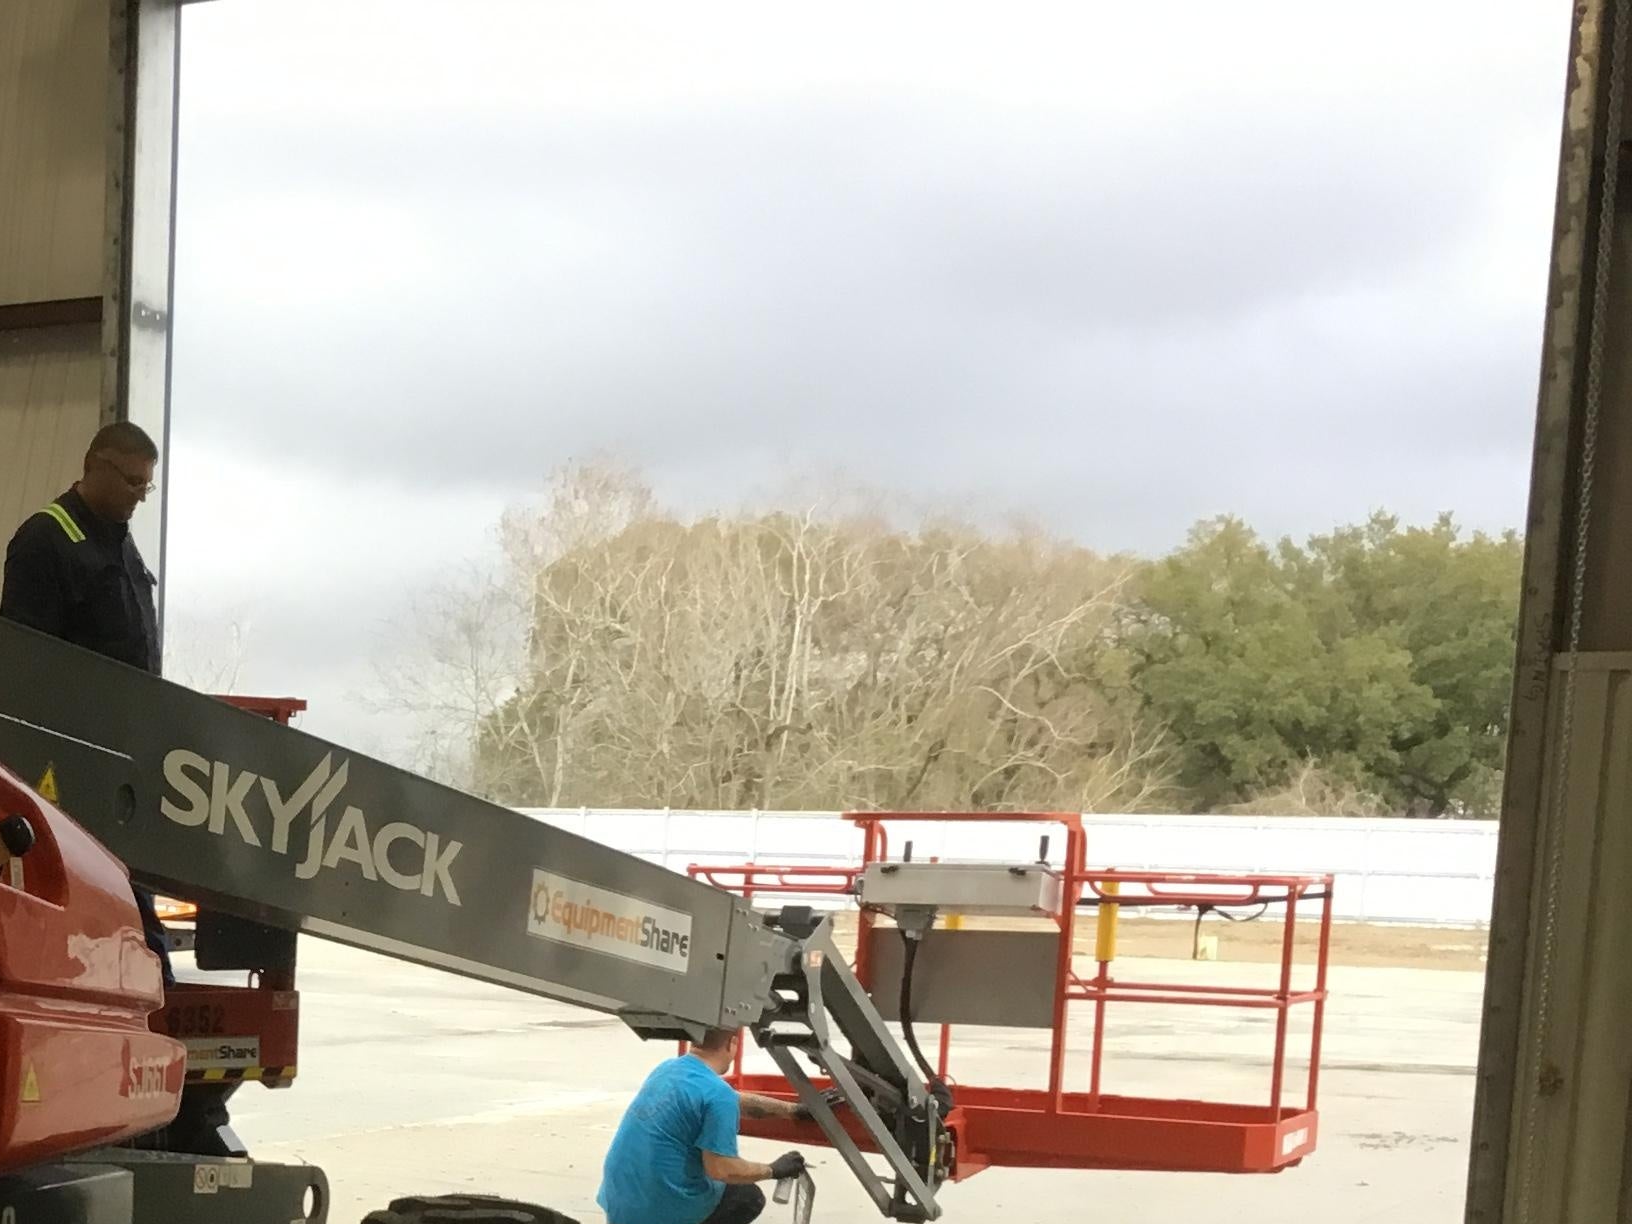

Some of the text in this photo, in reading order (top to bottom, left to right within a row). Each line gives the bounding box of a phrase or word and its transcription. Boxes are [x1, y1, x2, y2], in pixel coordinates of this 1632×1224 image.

[160, 749, 464, 907] SKYJACK
[551, 890, 689, 958] EquipmentShare
[187, 1045, 257, 1060] mentShare
